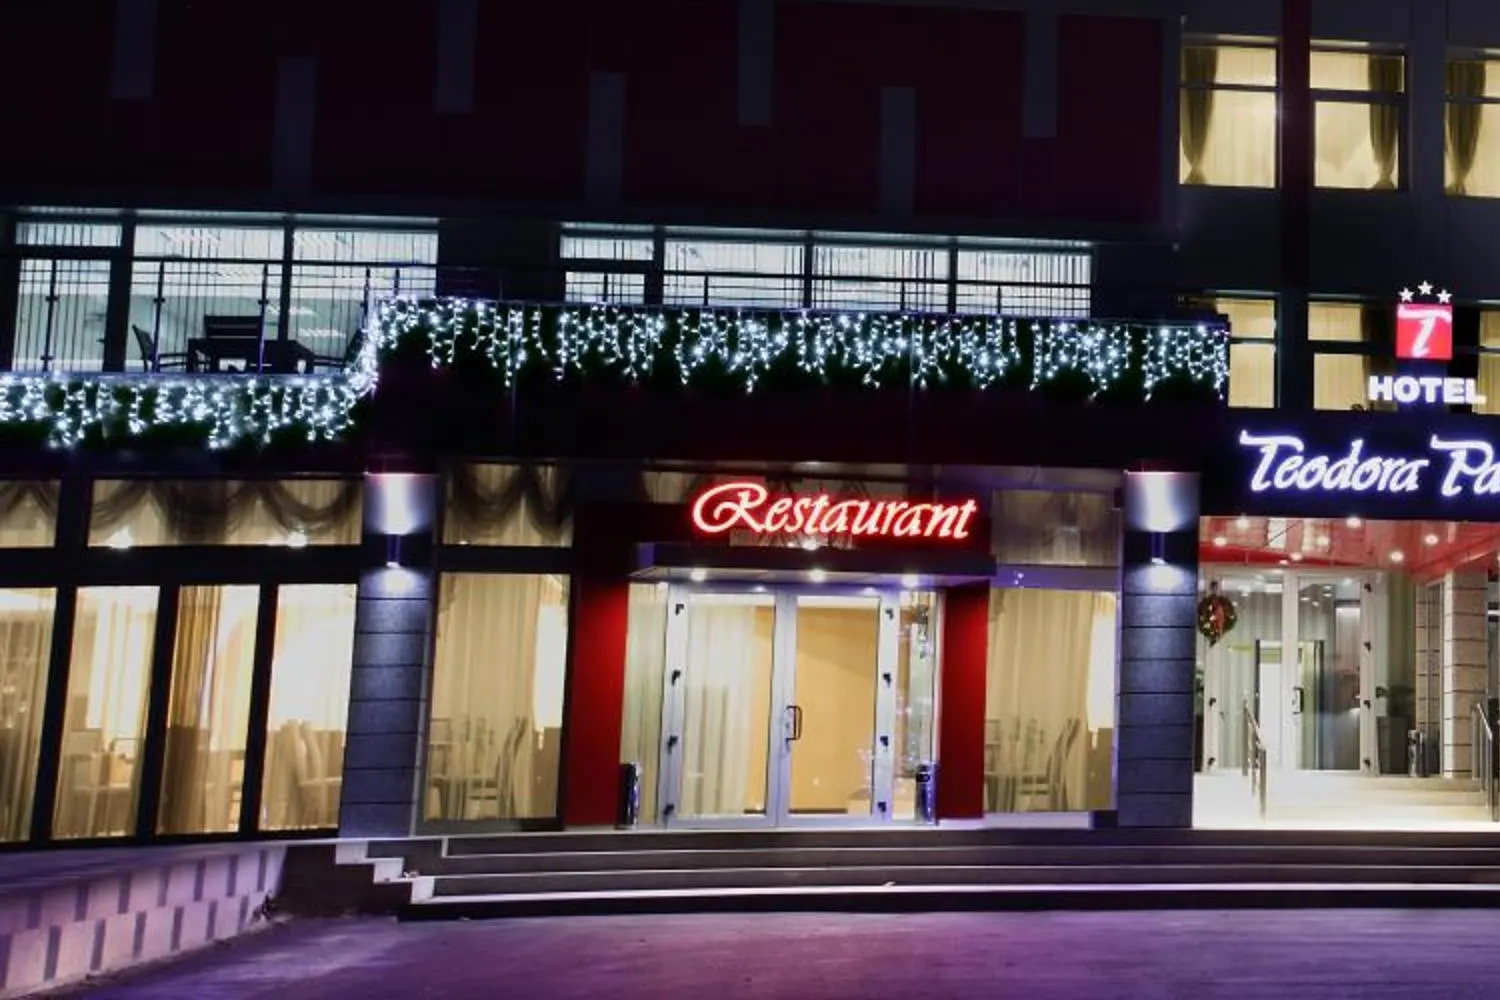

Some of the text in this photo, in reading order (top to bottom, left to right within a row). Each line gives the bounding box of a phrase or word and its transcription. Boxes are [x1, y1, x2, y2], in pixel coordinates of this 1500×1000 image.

[1368, 375, 1487, 405] HOTEL
[1239, 429, 1429, 492] Teodora
[692, 482, 978, 539] Restaurant
